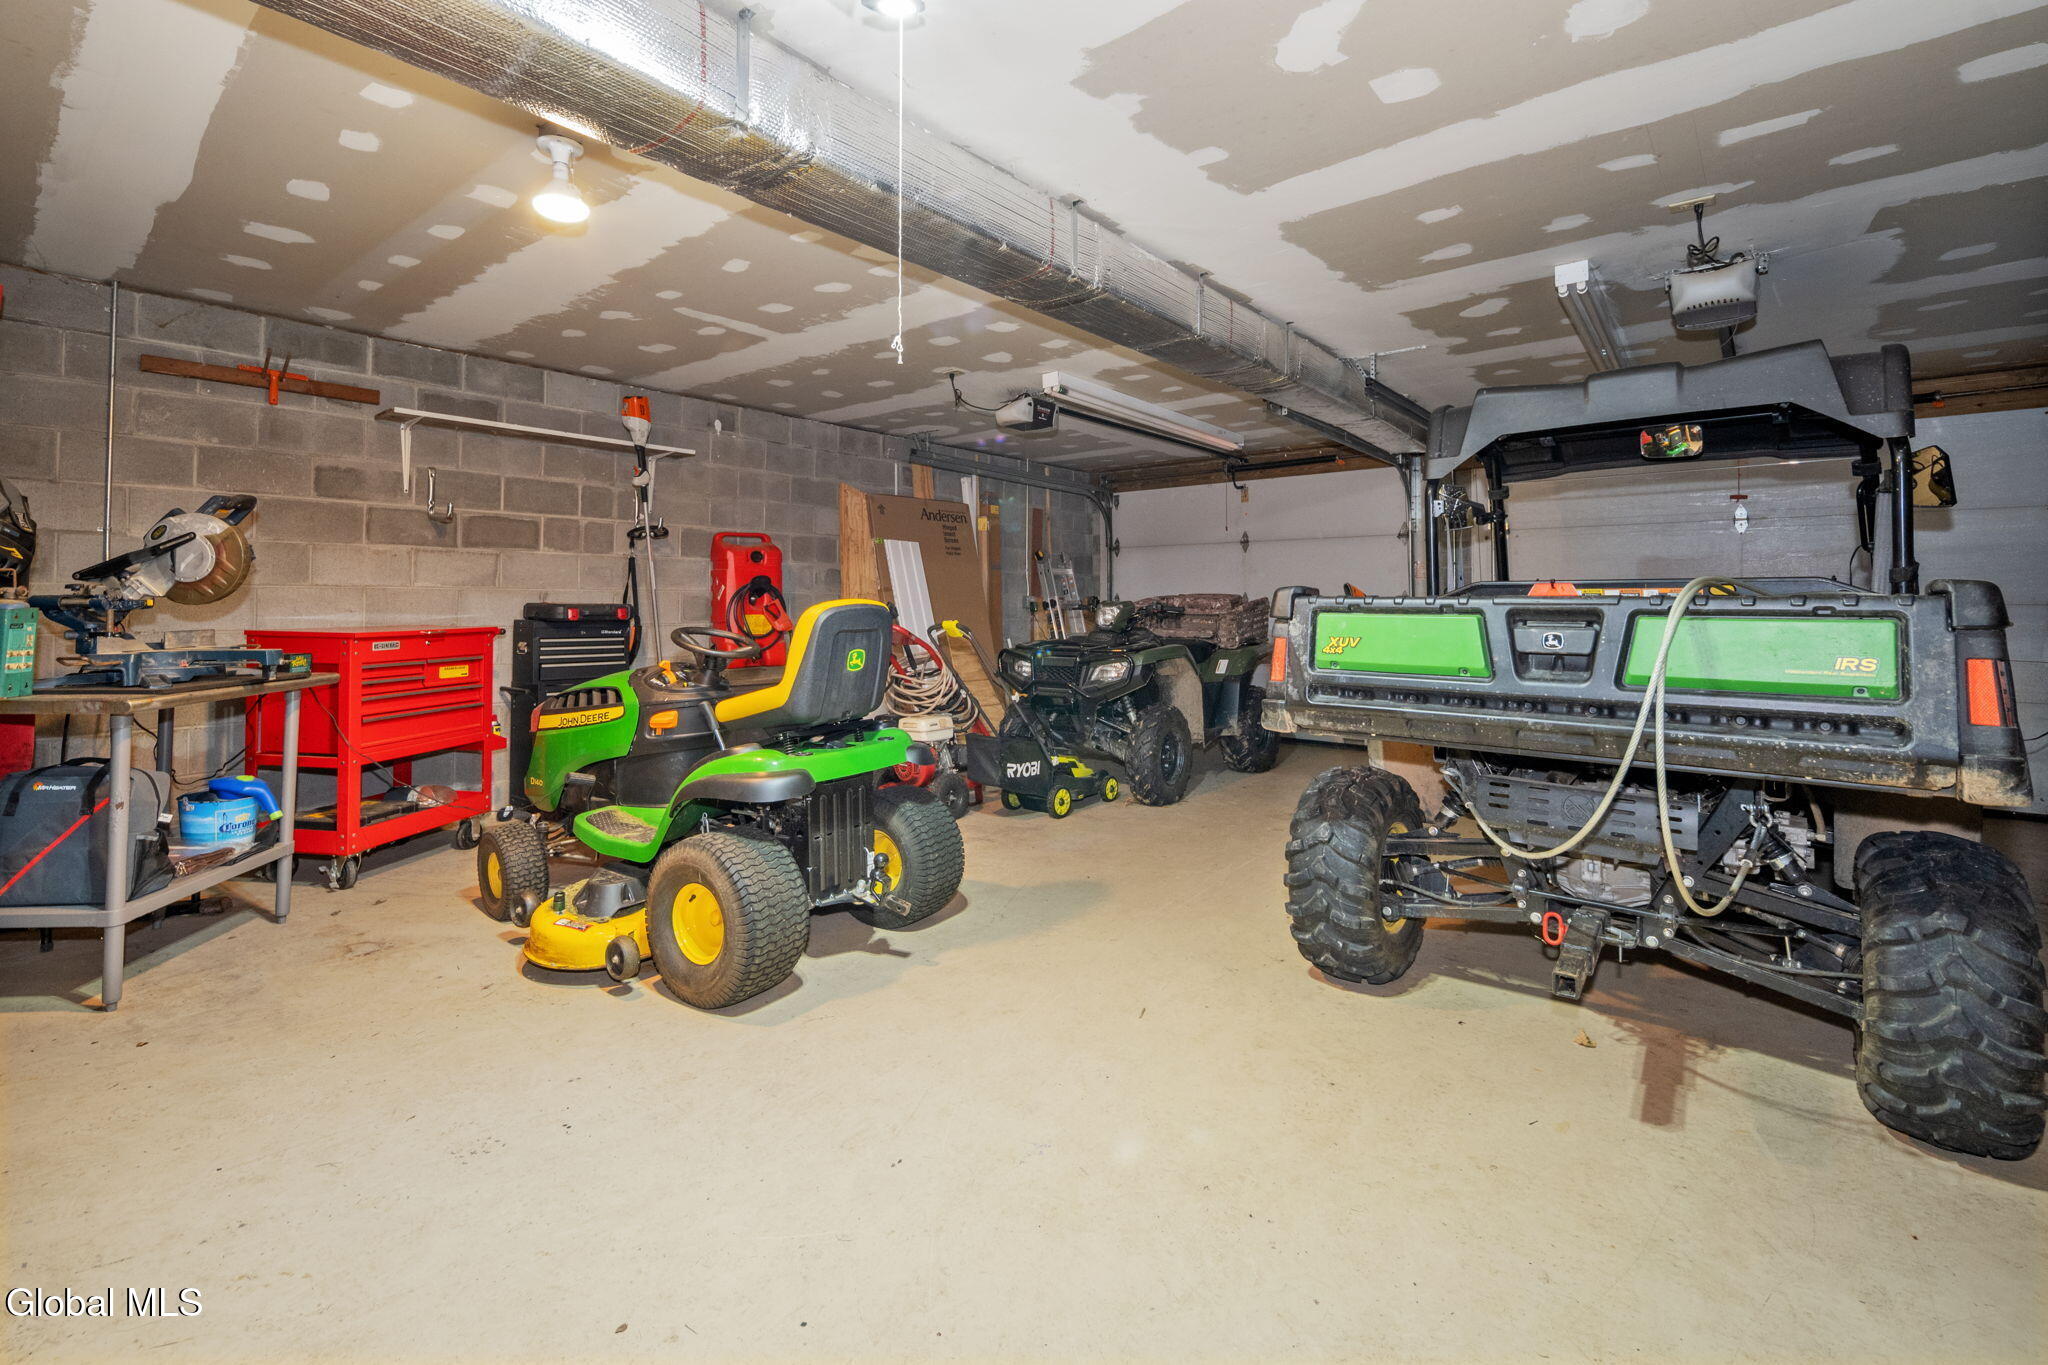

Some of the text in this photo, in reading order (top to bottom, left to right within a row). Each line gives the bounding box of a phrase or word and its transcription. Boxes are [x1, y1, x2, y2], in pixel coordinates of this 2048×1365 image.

[921, 507, 968, 523] Andersen
[1329, 636, 1361, 648] XUV
[1834, 657, 1879, 672] IRS
[558, 711, 610, 727] JOHN DEERE
[1006, 760, 1041, 778] RYOBI
